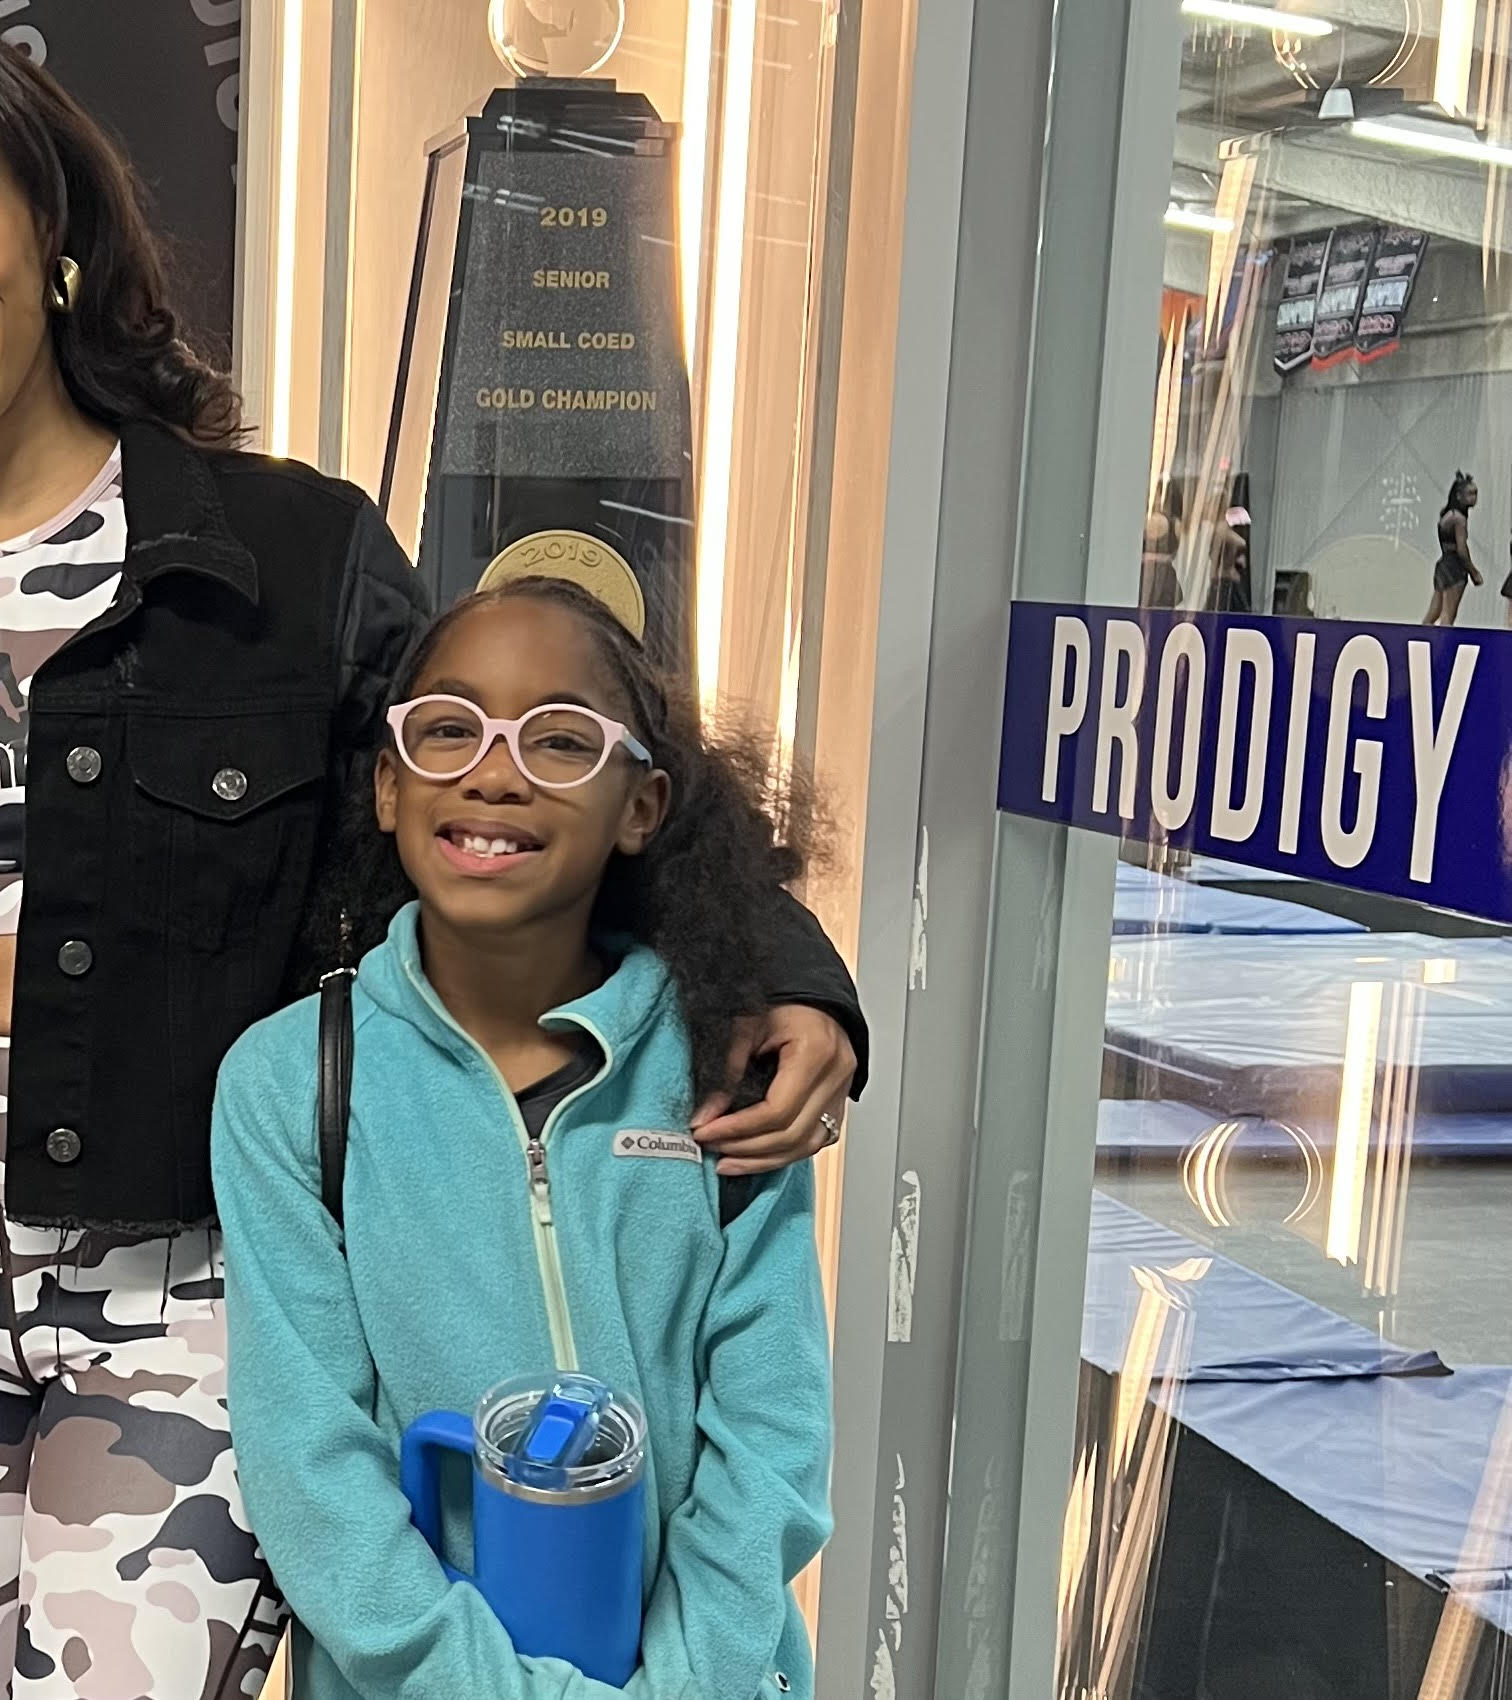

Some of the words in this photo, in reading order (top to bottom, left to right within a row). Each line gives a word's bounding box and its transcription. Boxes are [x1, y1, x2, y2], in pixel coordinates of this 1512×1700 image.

[540, 207, 608, 227] 2019
[532, 270, 610, 289] SENIOR
[503, 330, 571, 349] SMALL
[577, 332, 635, 350] COED
[476, 387, 535, 409] GOLD
[542, 389, 656, 411] CHAMPION
[520, 542, 603, 568] 2019
[1041, 615, 1481, 885] PRODIGY
